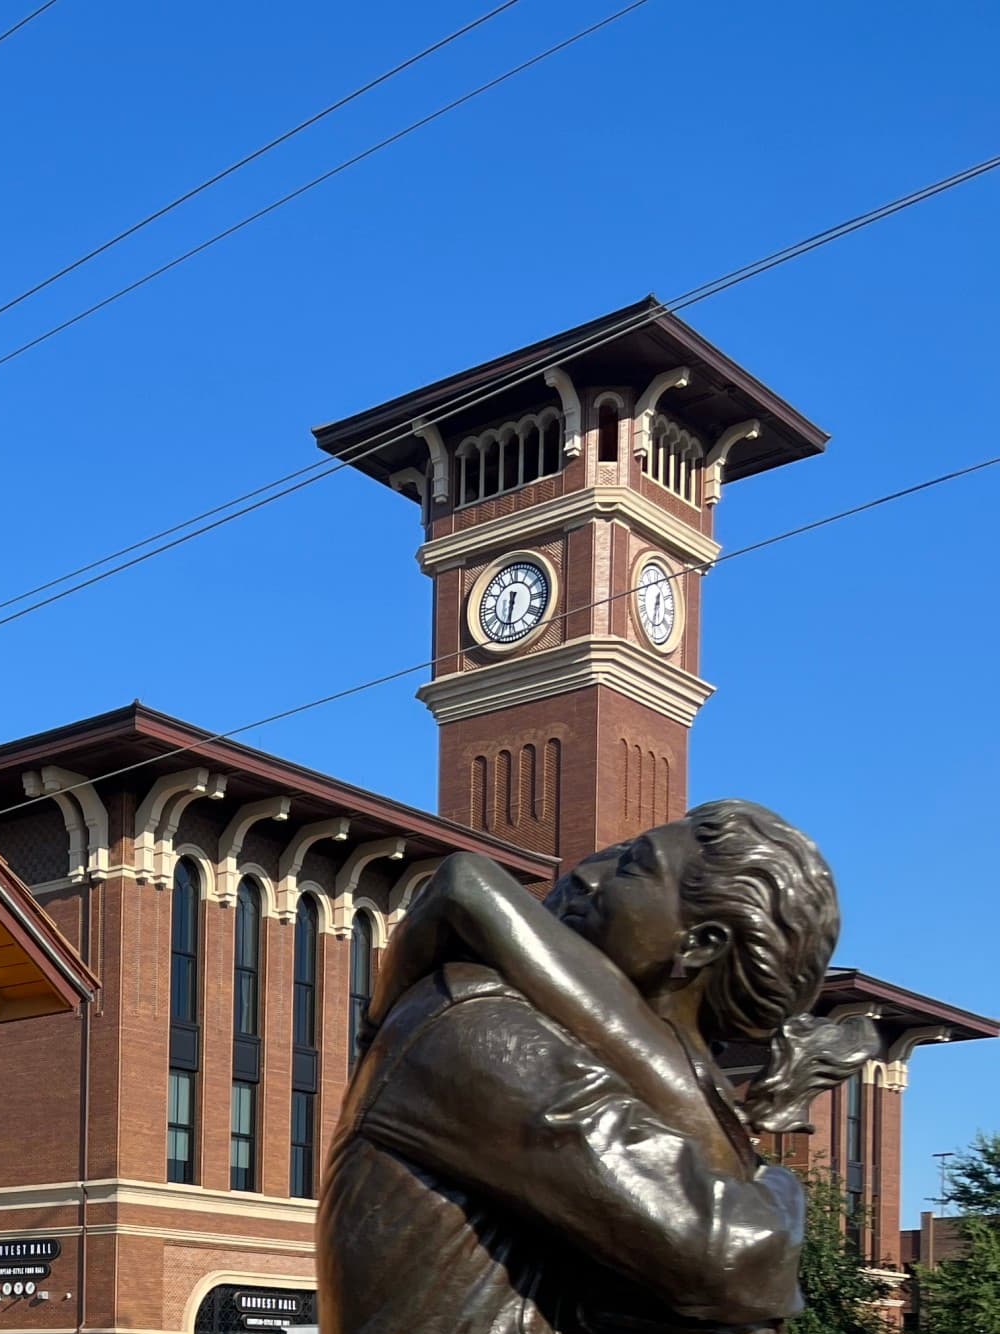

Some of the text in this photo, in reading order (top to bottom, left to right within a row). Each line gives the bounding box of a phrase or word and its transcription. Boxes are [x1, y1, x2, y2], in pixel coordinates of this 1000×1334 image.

[30, 1243, 51, 1254] HALL
[241, 1296, 296, 1310] HARVEST HALL
